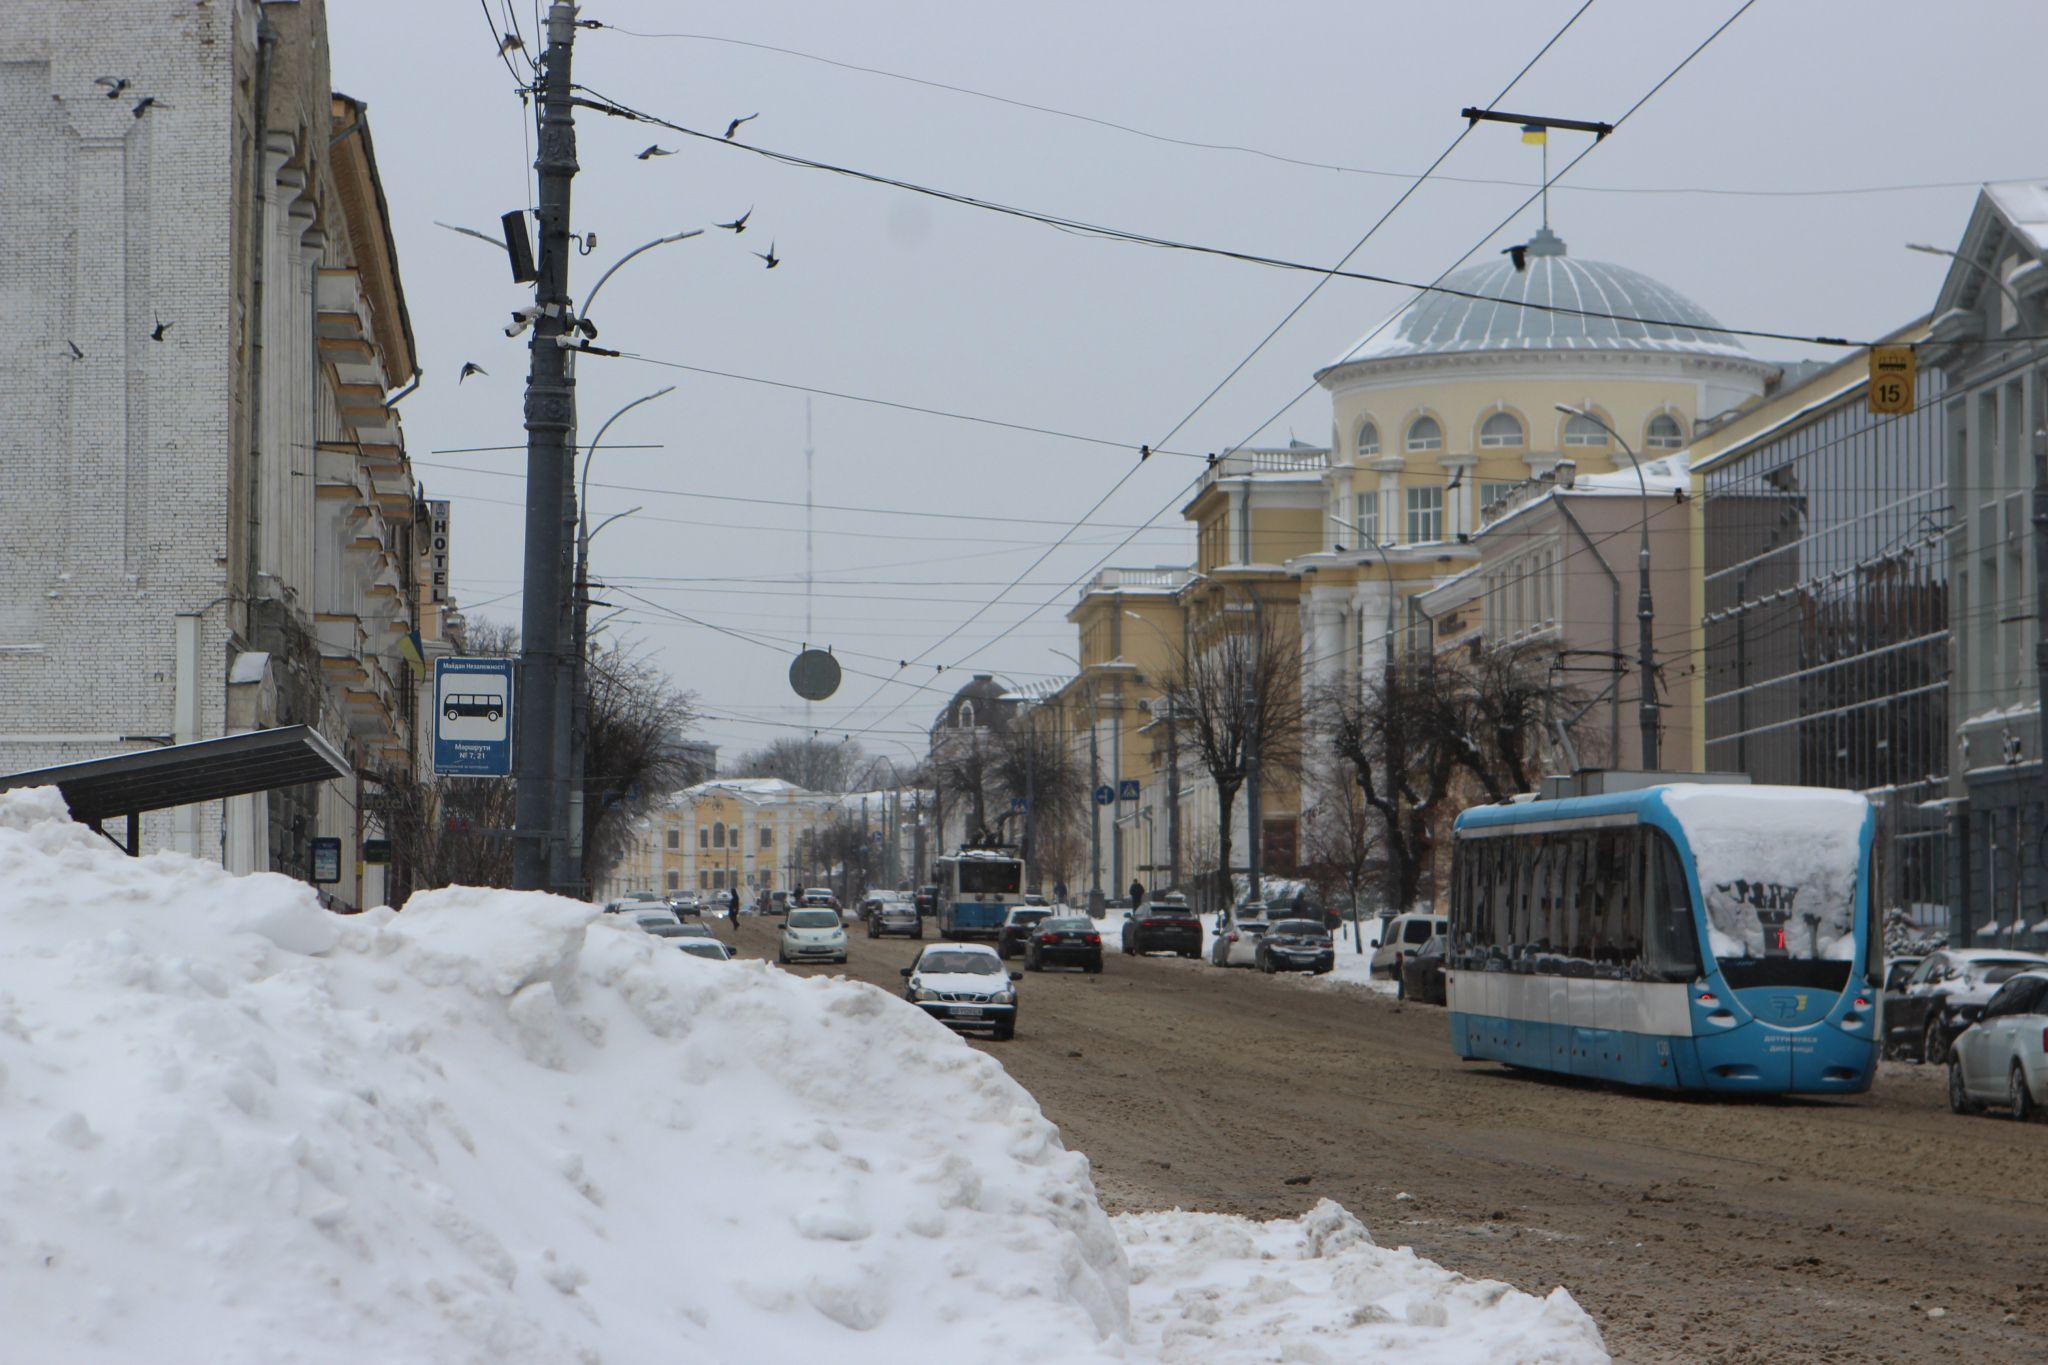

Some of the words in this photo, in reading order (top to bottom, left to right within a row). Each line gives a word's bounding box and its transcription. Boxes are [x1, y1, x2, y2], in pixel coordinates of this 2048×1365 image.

[1879, 384, 1901, 403] 15
[433, 520, 446, 602] HOTEL
[455, 743, 491, 752] Маршрути
[477, 752, 485, 760] 21
